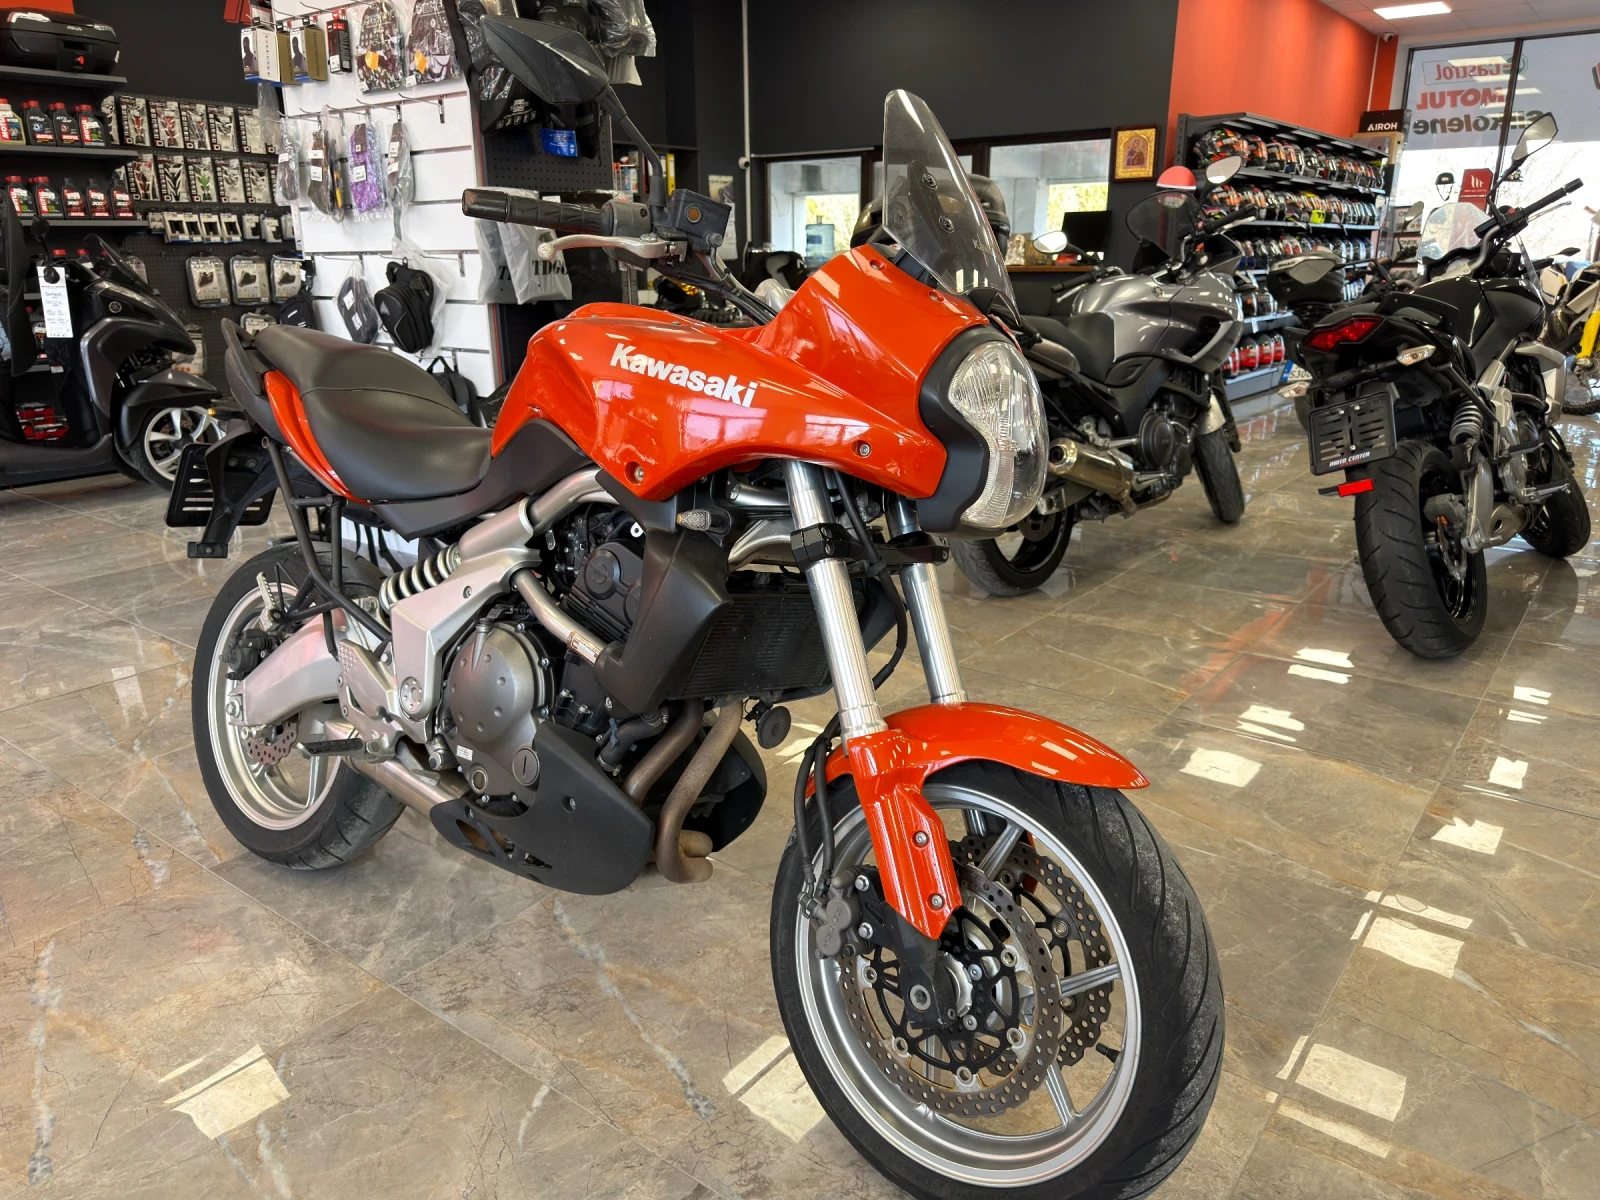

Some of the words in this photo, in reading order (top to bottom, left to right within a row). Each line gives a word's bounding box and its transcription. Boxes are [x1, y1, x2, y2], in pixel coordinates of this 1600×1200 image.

[1367, 122, 1398, 131] AIROH
[610, 343, 758, 408] Kawasaki
[1329, 458, 1347, 467] MOTO
[1348, 451, 1371, 462] CENTER
